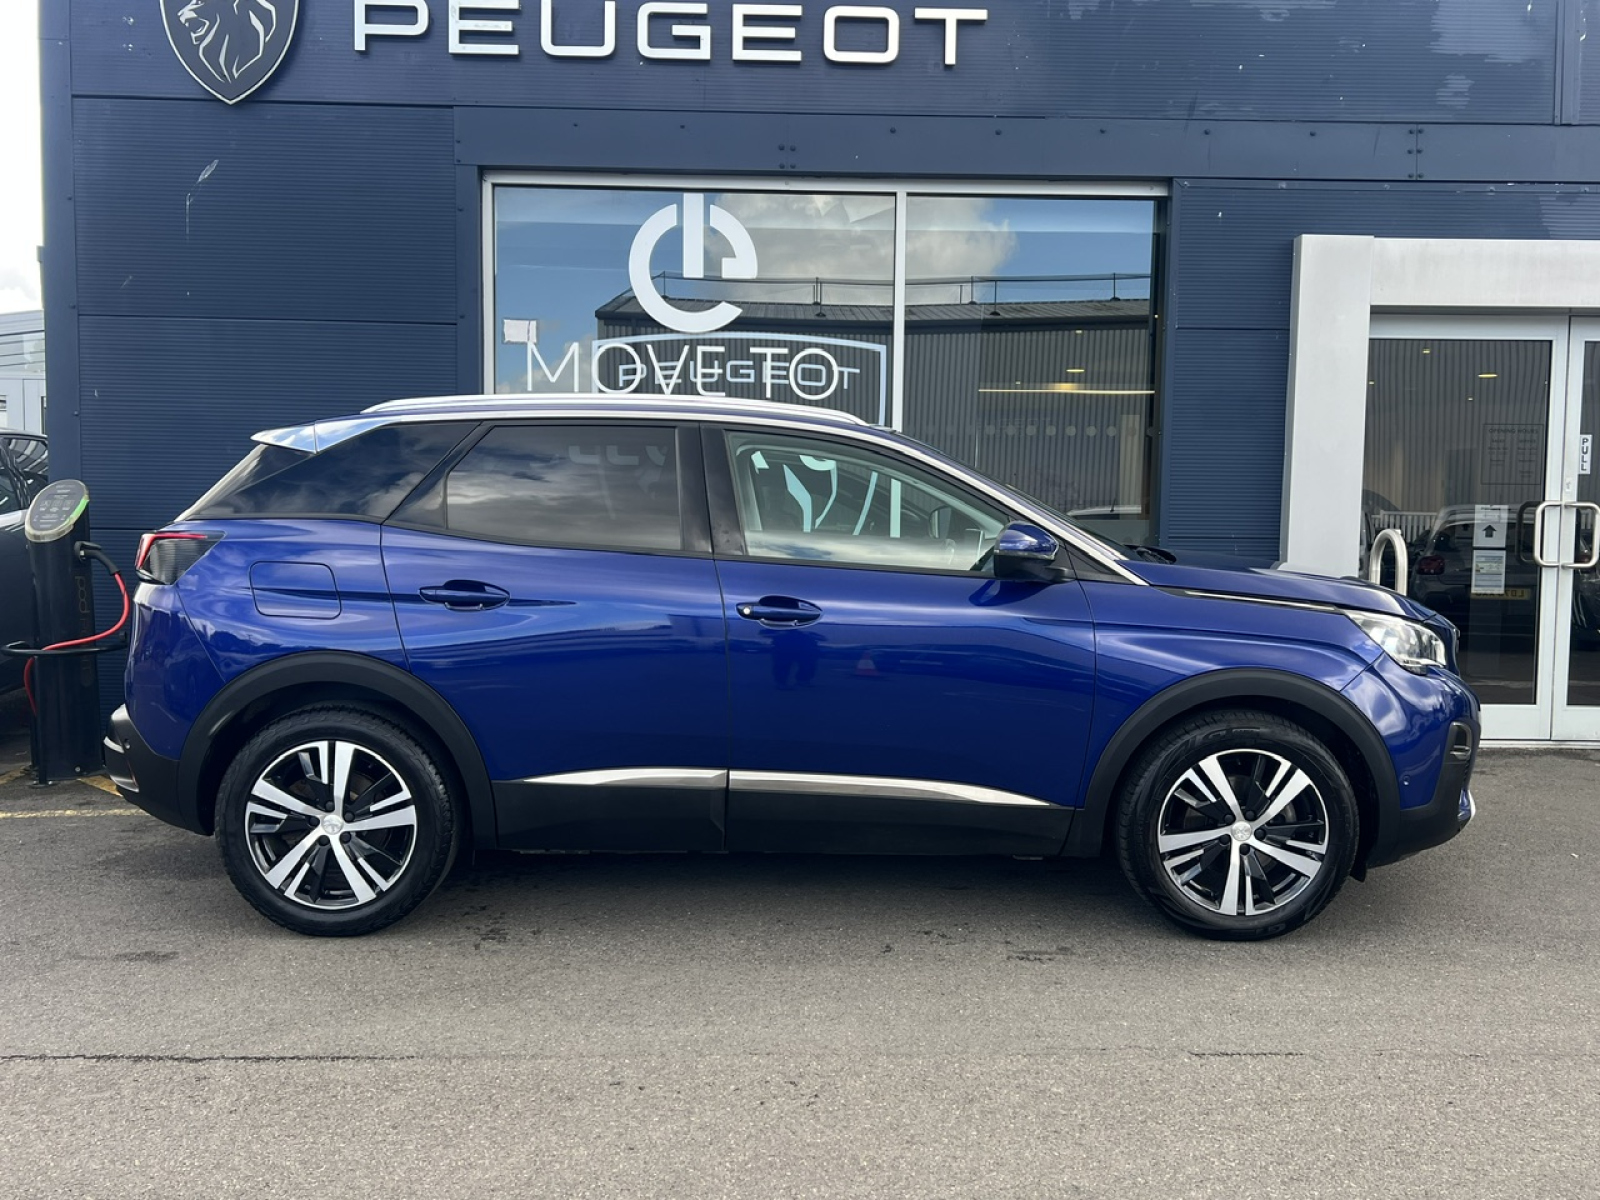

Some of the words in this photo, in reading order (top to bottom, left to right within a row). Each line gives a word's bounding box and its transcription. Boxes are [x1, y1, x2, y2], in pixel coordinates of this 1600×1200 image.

[354, 0, 988, 66] PEUGEOT
[526, 341, 726, 397] MOVE
[749, 347, 840, 401] TO
[618, 359, 861, 390] PEUGEOT
[1580, 437, 1590, 472] PULL
